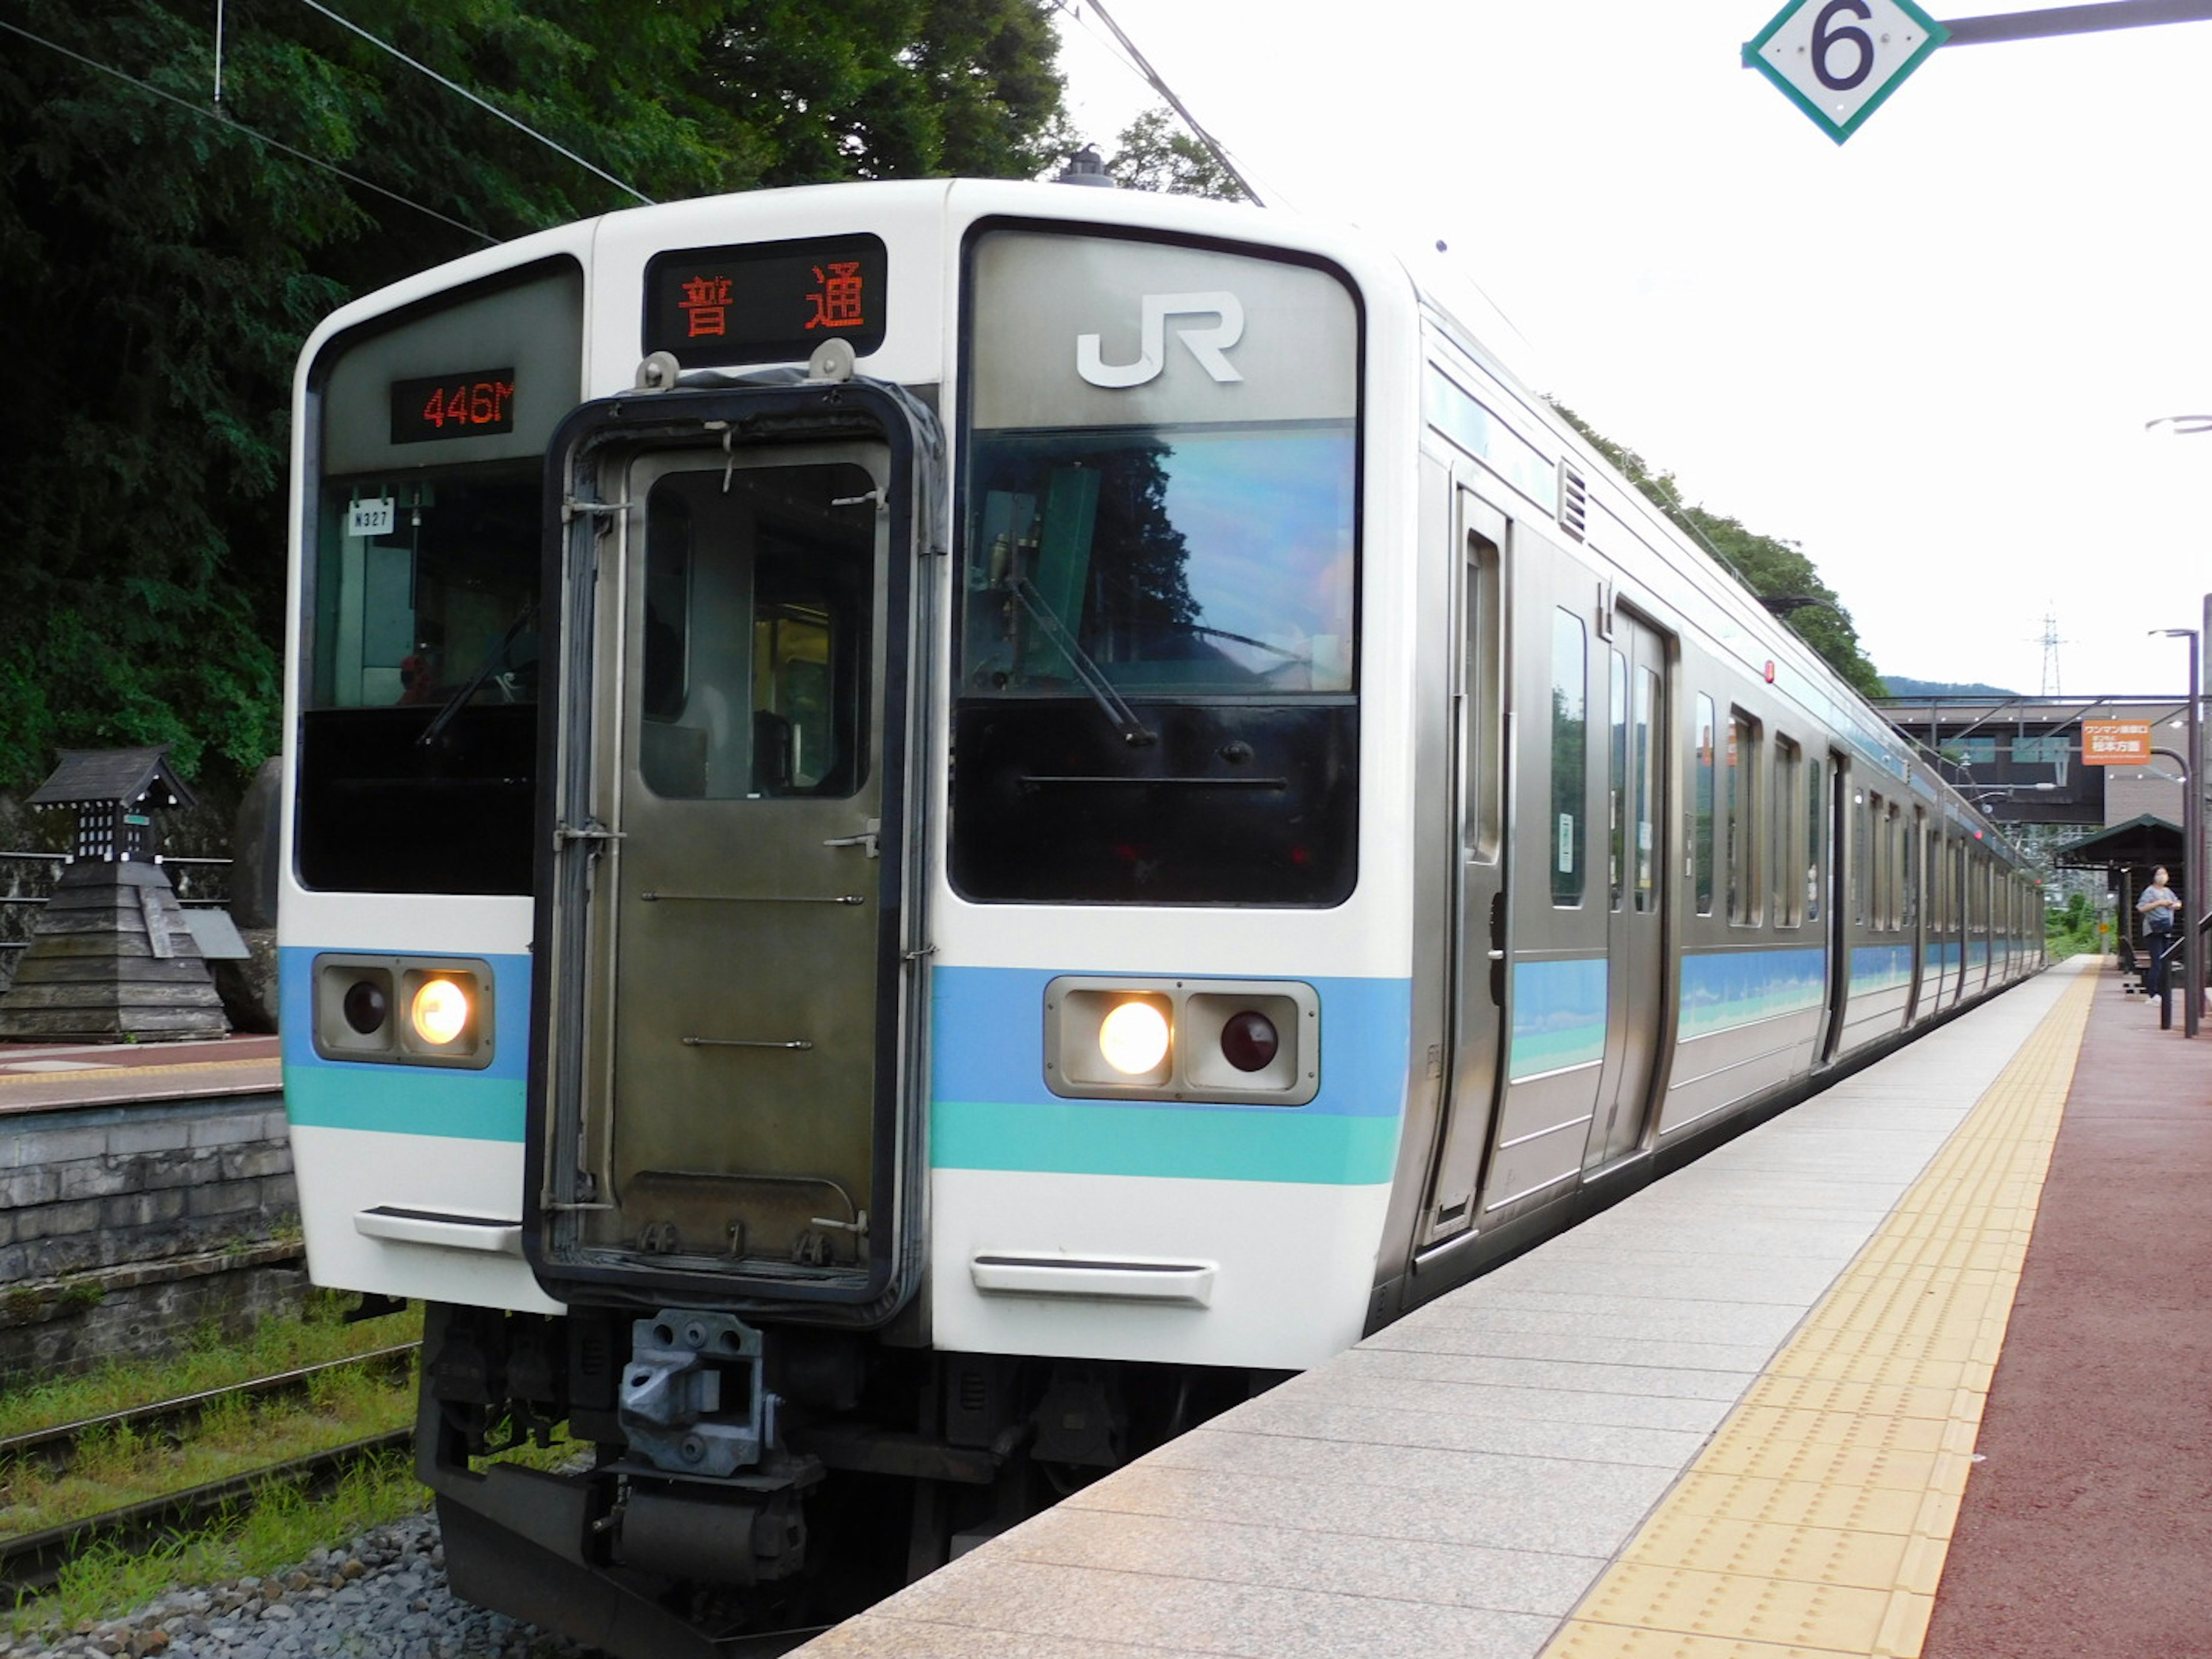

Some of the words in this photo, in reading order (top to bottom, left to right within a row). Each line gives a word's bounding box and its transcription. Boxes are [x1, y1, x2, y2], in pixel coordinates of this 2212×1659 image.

[1811, 0, 1874, 91] 6
[678, 262, 864, 338] 普通
[1076, 291, 1244, 388] JR
[355, 511, 386, 527] N327
